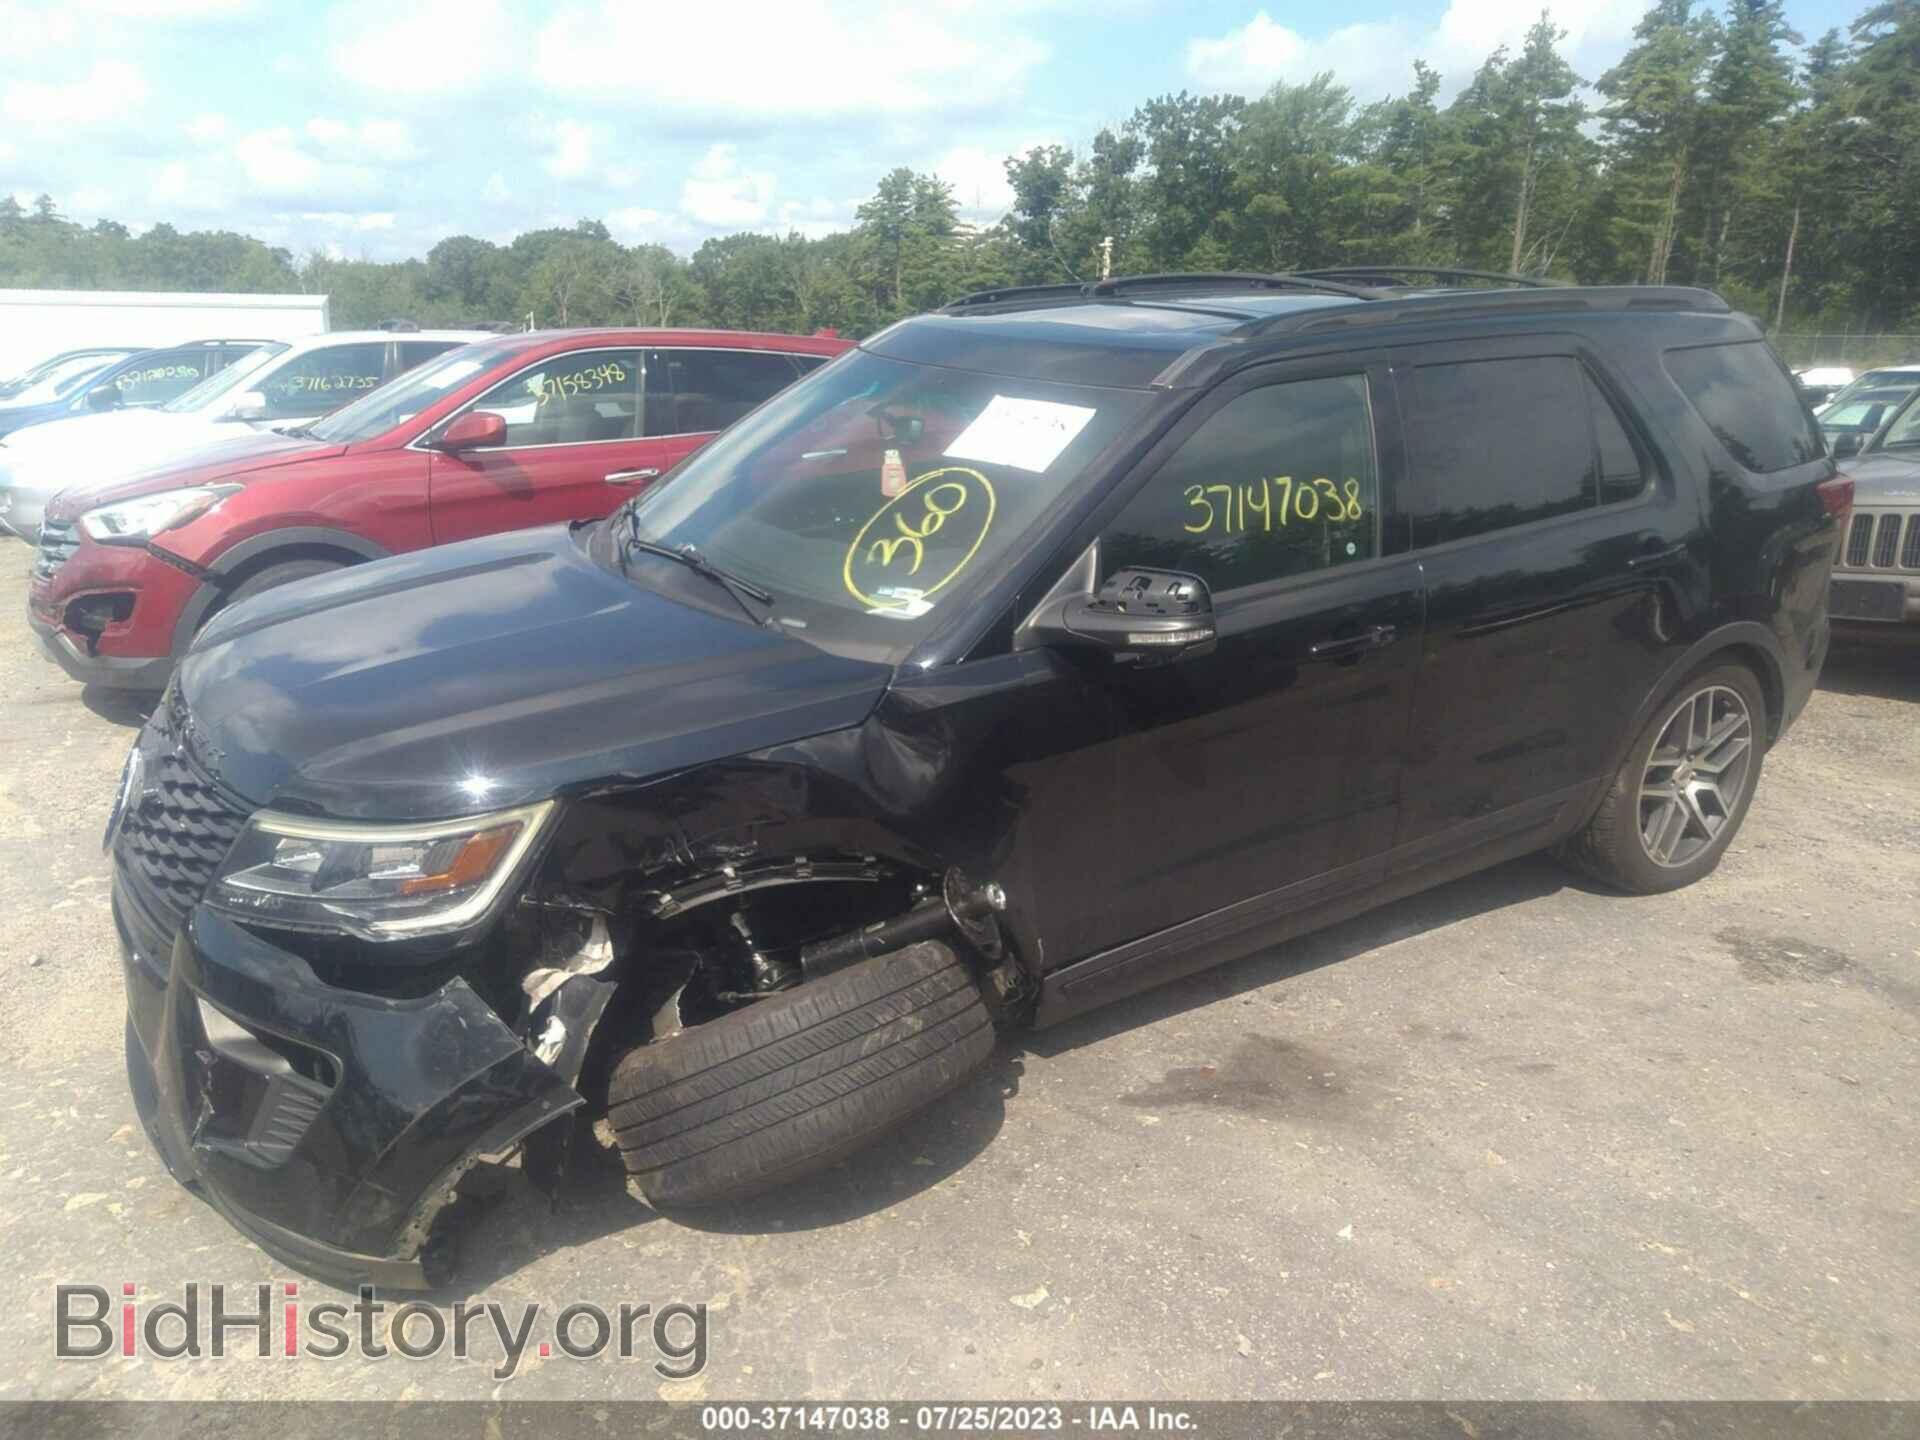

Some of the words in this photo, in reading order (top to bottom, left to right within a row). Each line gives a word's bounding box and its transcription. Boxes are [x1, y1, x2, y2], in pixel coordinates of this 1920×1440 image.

[527, 362, 626, 408] 37158348
[866, 483, 967, 576] 360
[1184, 476, 1363, 533] 37147038
